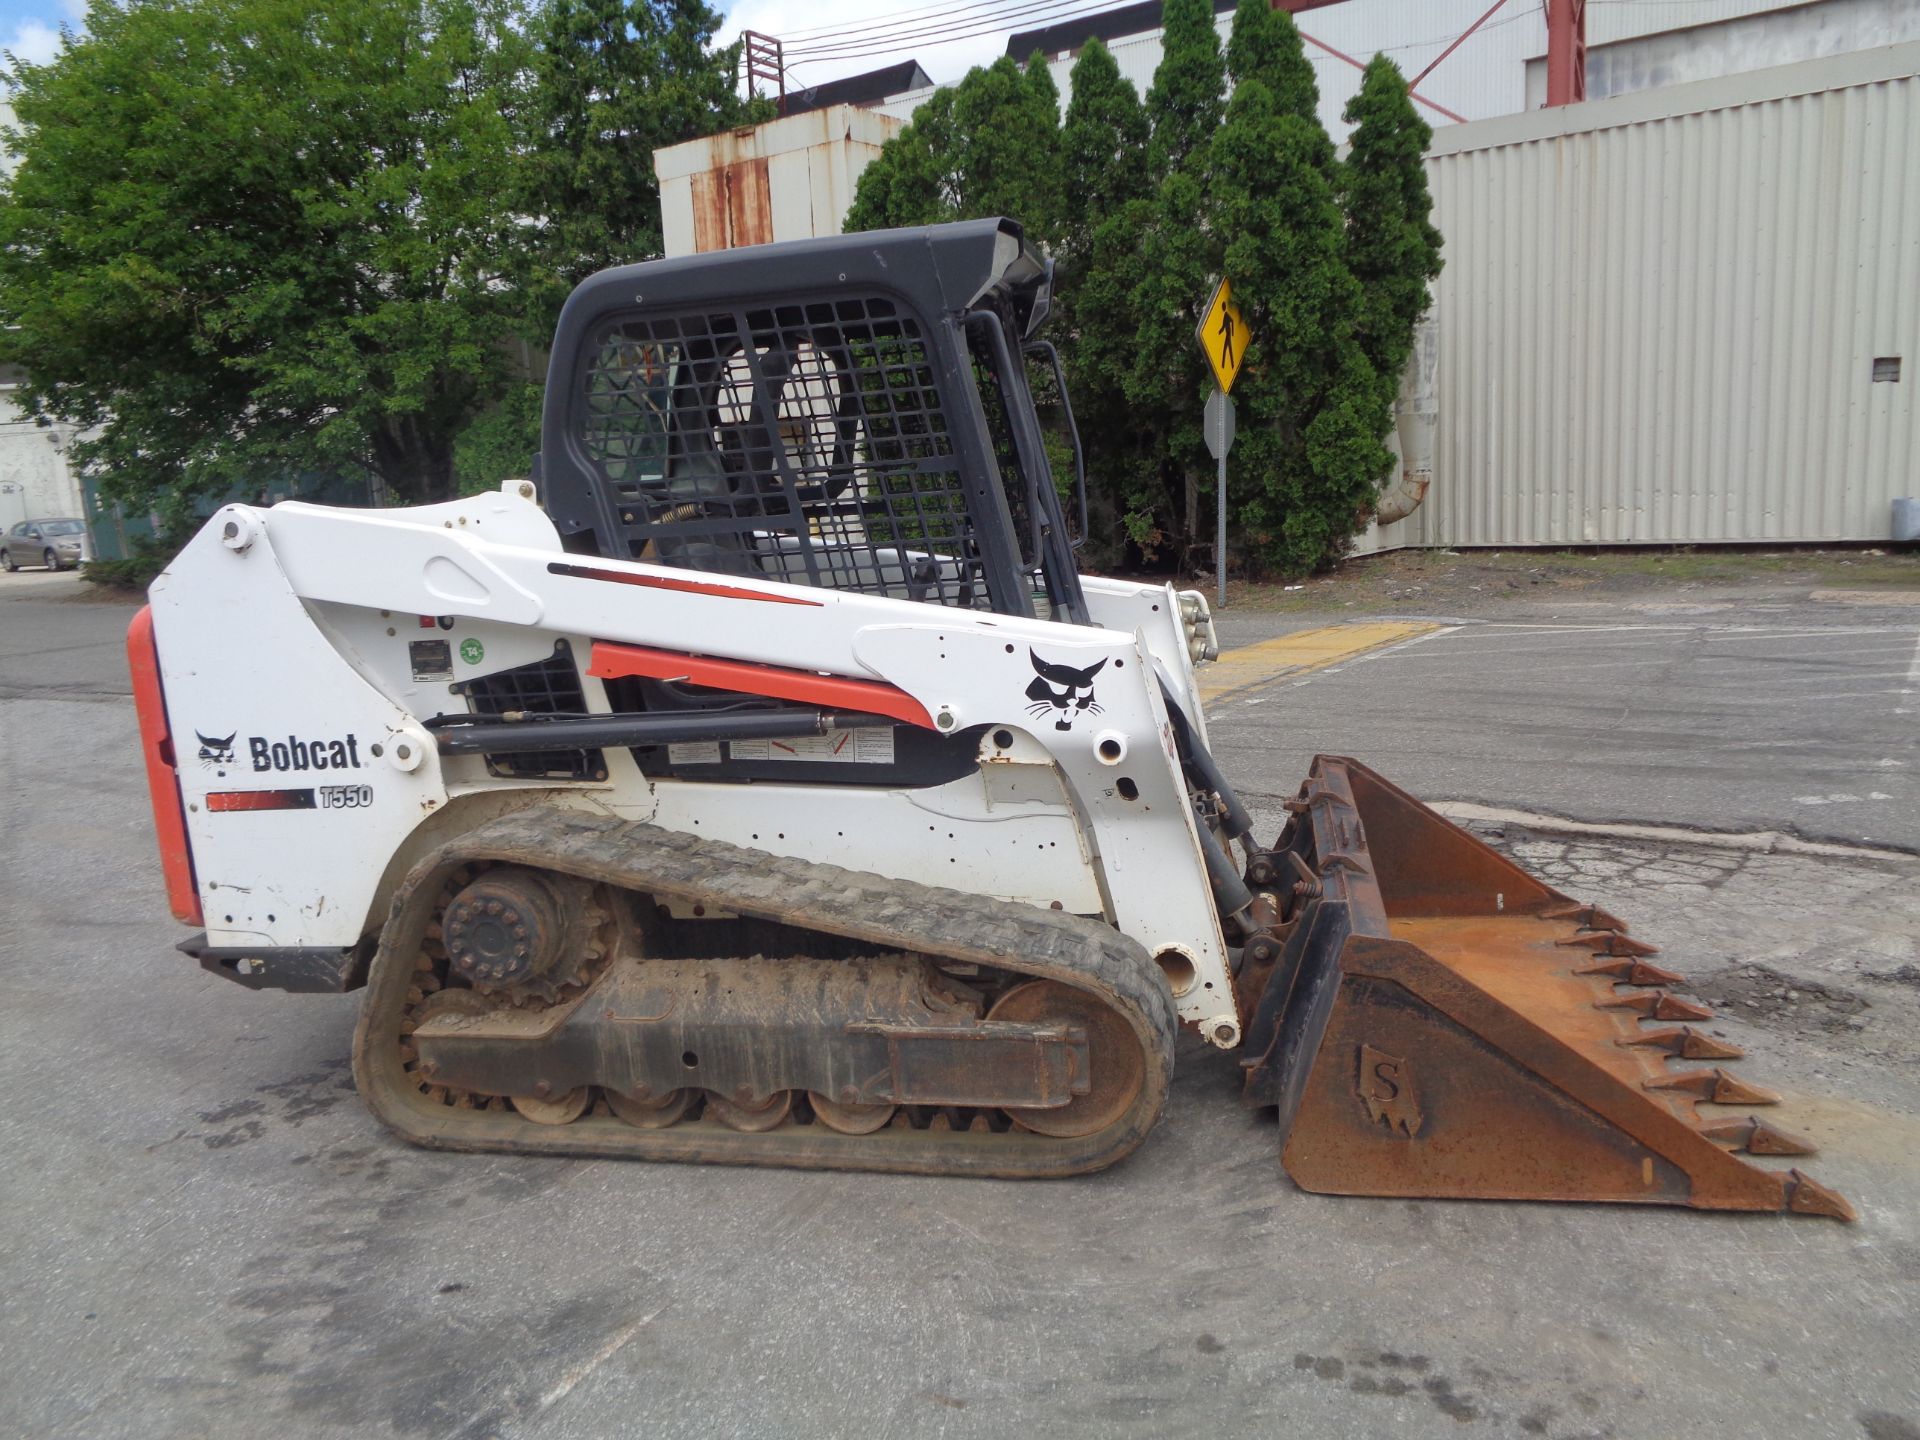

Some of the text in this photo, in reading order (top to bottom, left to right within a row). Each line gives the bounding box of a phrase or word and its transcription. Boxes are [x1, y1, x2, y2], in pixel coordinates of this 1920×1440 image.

[249, 734, 361, 771] Bobcat
[320, 784, 373, 809] T550
[1372, 1063, 1398, 1101] S
